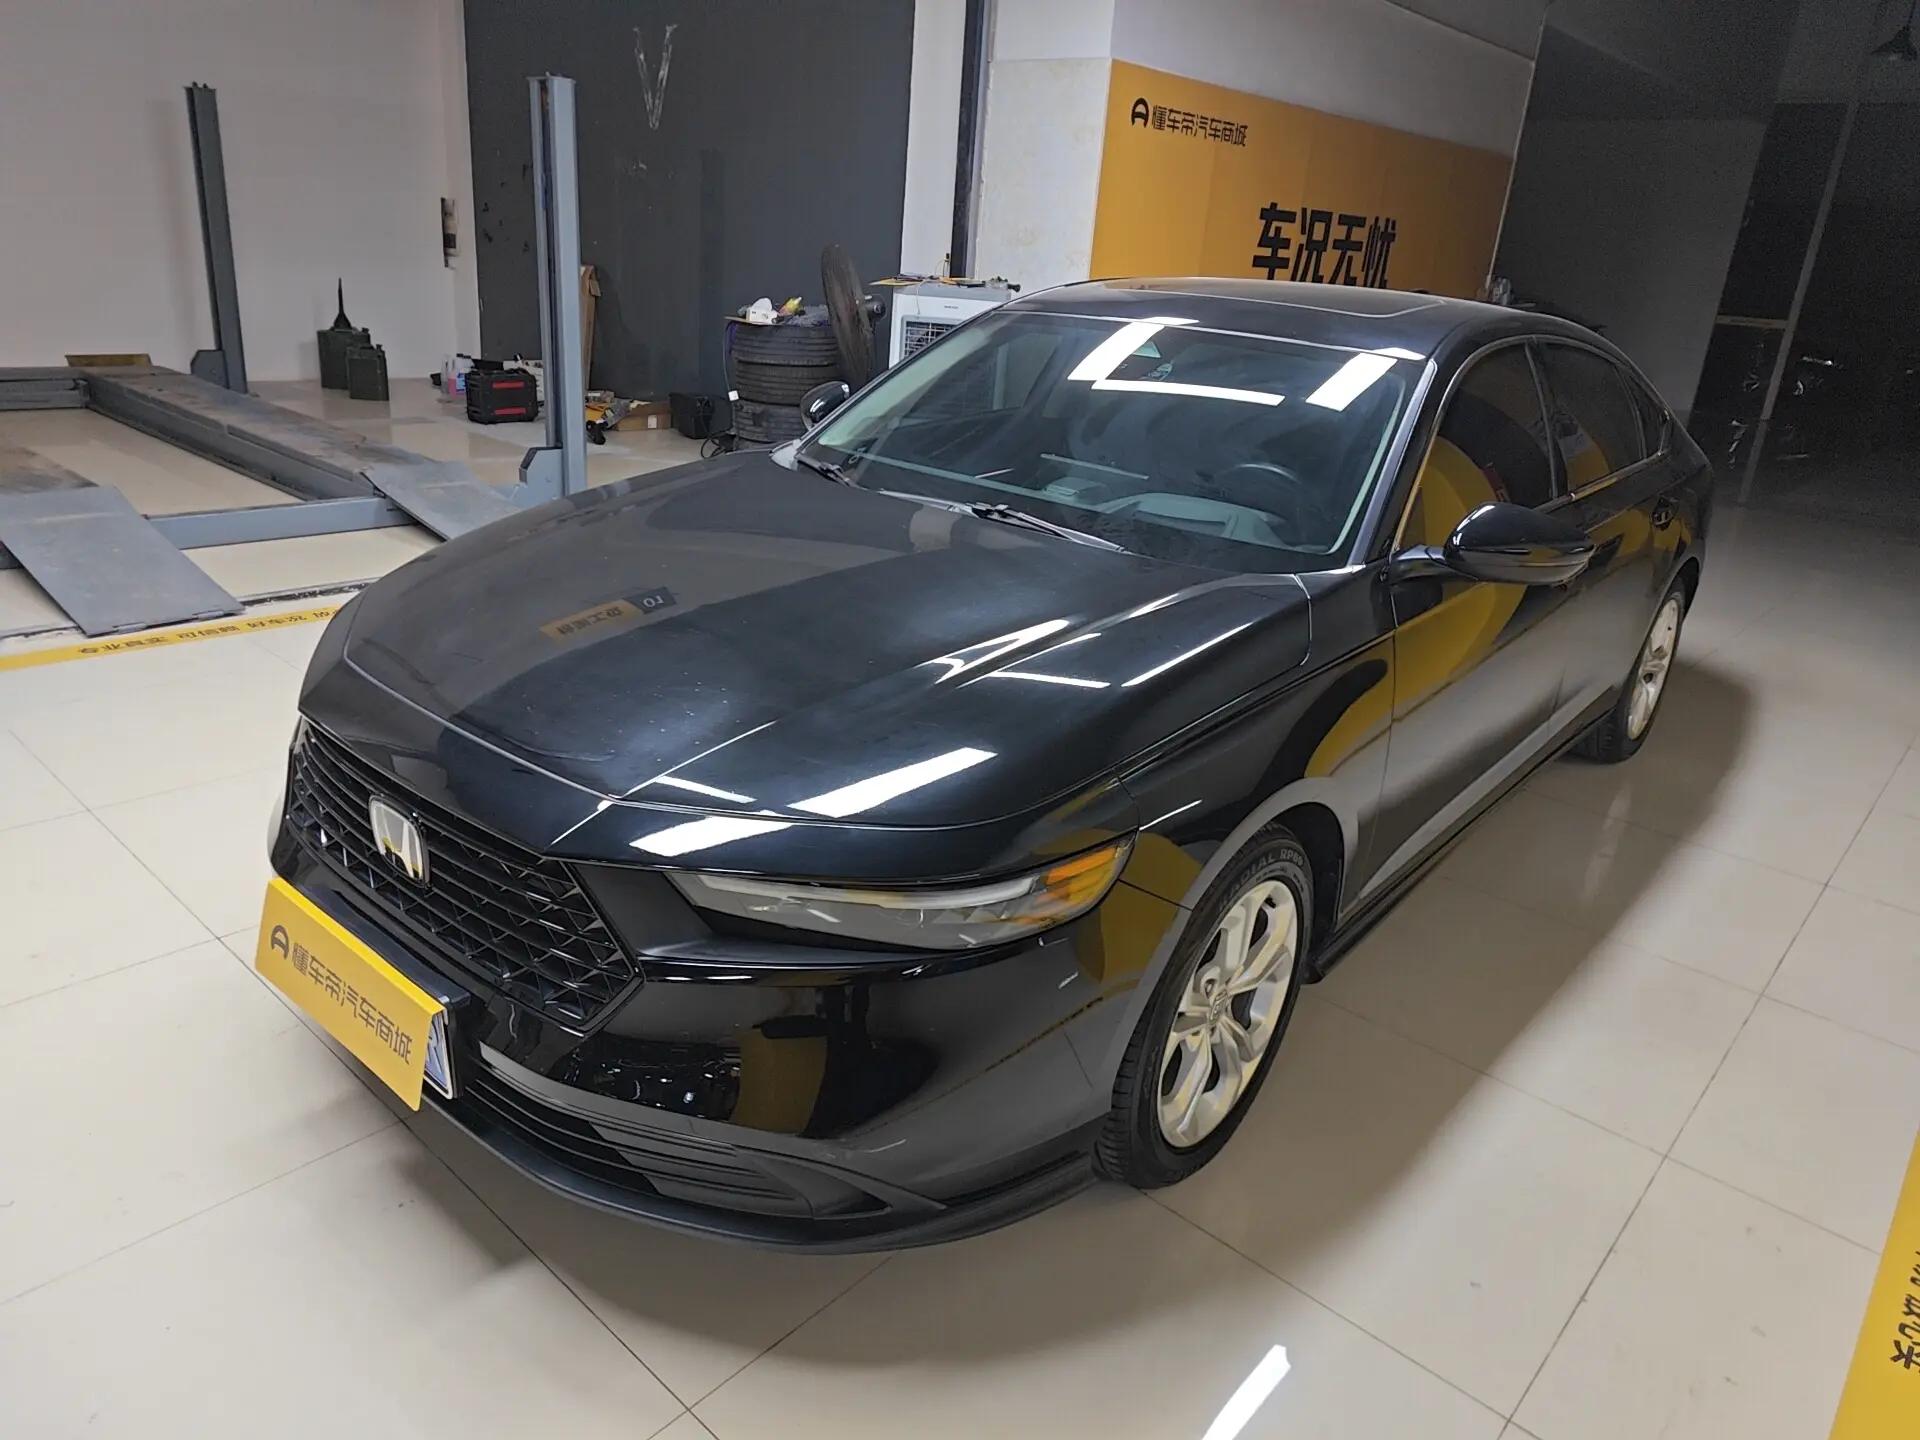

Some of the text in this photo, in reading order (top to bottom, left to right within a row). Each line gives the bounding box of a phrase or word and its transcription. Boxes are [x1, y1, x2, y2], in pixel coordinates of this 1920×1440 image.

[1152, 105, 1248, 147] 懂车帝汽车商城
[1252, 202, 1396, 289] 车况无忧
[293, 943, 413, 1065] 懂车帝汽车商城
